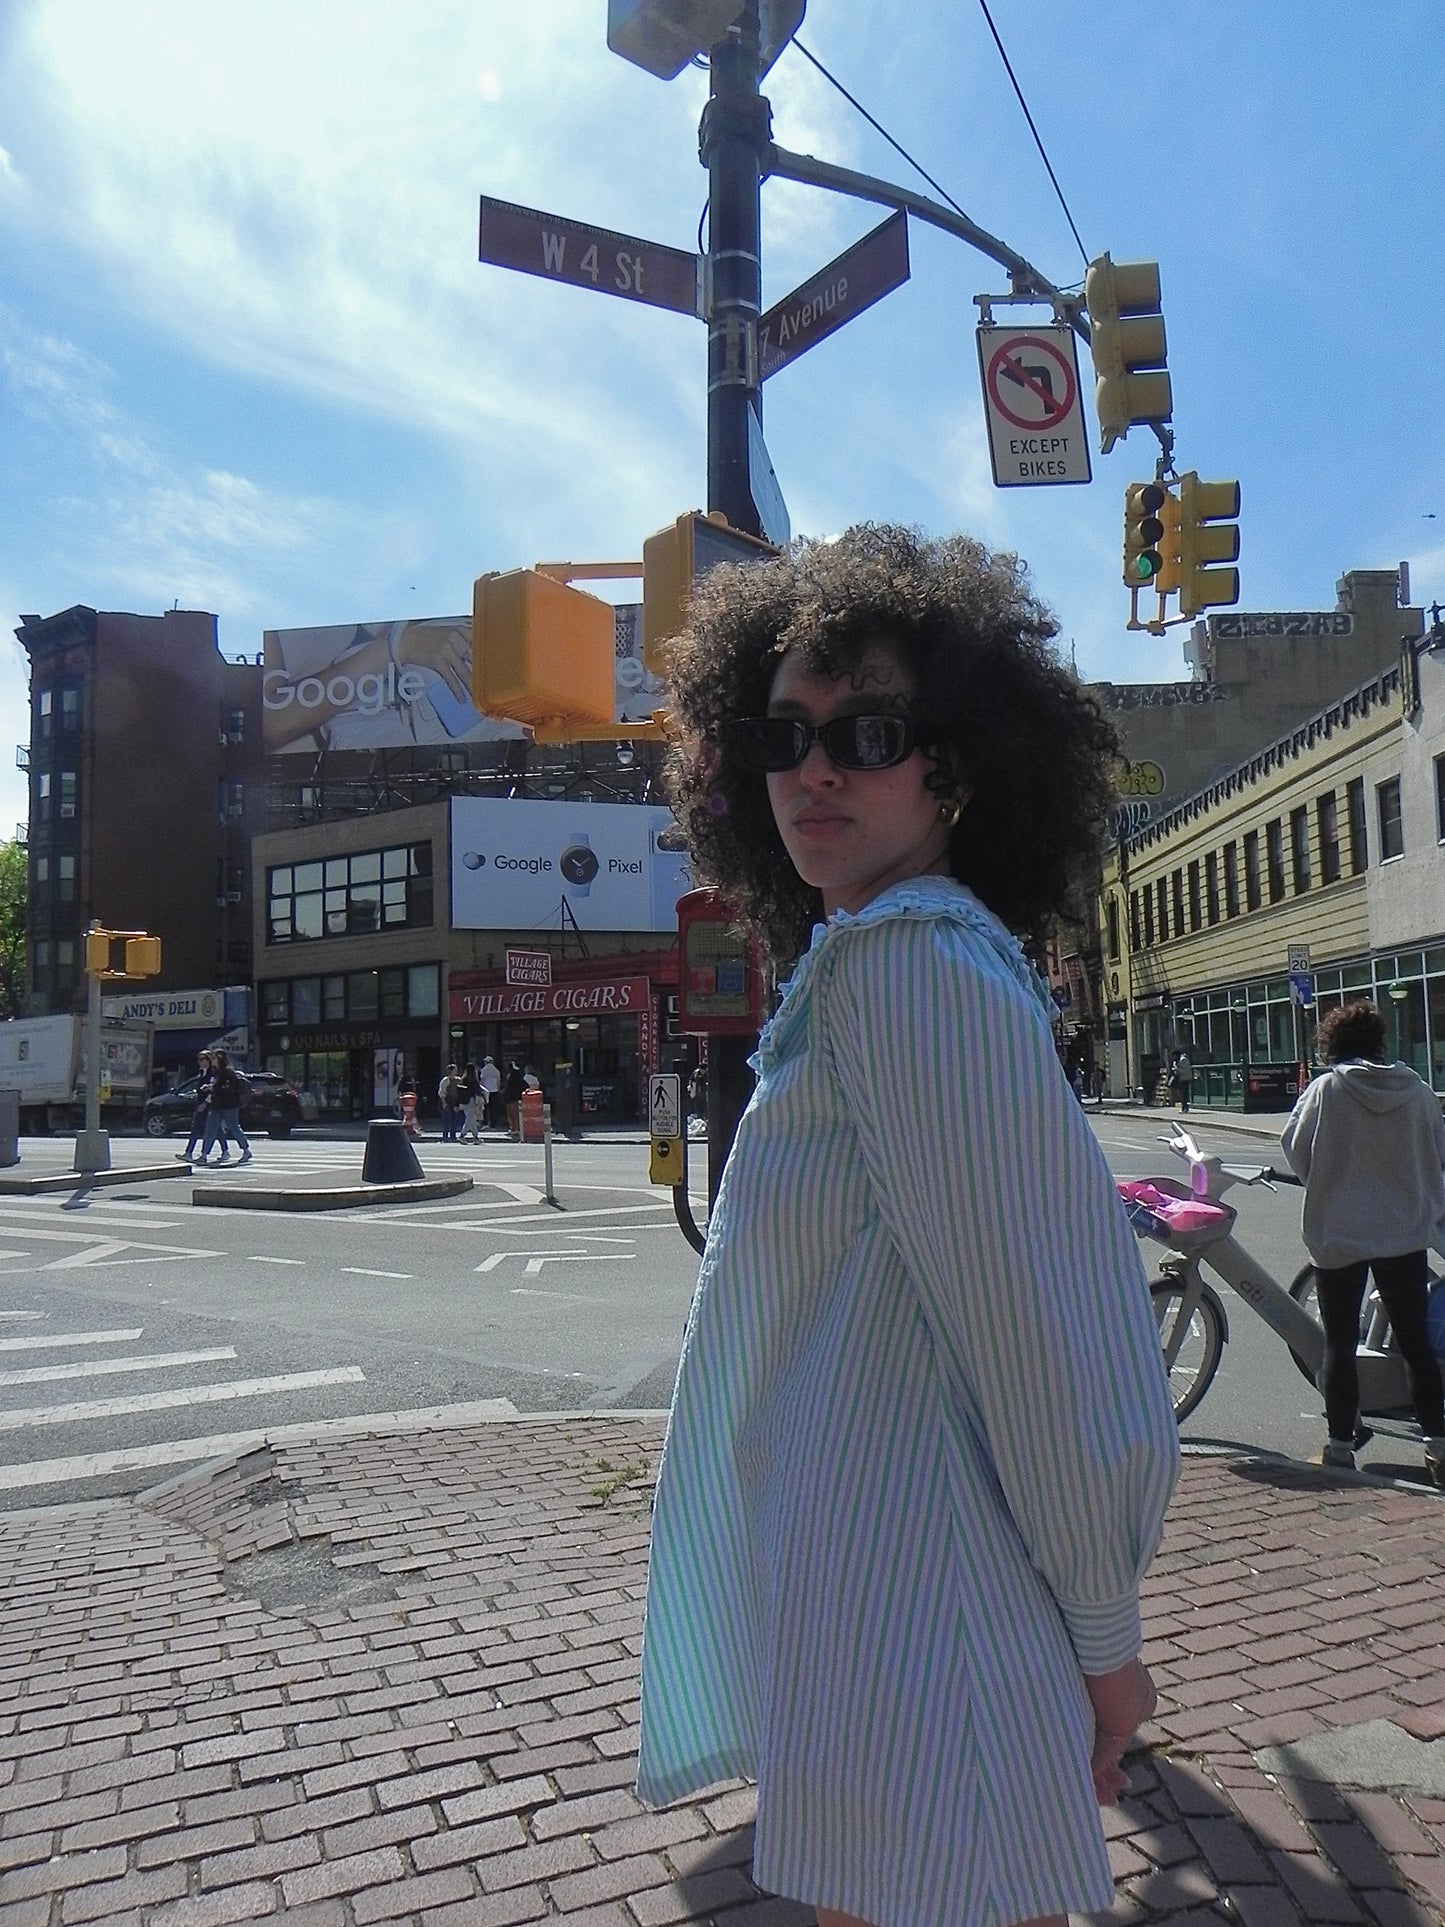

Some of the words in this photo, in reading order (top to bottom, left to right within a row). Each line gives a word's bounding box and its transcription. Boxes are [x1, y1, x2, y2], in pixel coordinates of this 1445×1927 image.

[542, 231, 567, 273] W
[580, 244, 600, 283] 4
[614, 252, 645, 294] St
[760, 325, 771, 357] 7
[779, 277, 848, 346] Avenue
[1010, 438, 1069, 454] EXCEPT
[1019, 460, 1067, 477] BIKES
[263, 661, 426, 716] Google
[494, 854, 553, 875] Google
[608, 858, 643, 874] Pixel
[510, 956, 549, 970] VILLAGE
[1292, 959, 1308, 971] 20
[510, 967, 549, 984] CIGARS
[122, 1002, 165, 1018] ANDY'S
[168, 1000, 197, 1016] DELI
[463, 991, 547, 1015] VILLAGE
[552, 985, 632, 1010] CIGARS
[315, 1032, 348, 1048] NAILS
[359, 1030, 382, 1046] SPA
[641, 1012, 649, 1060] CANDY
